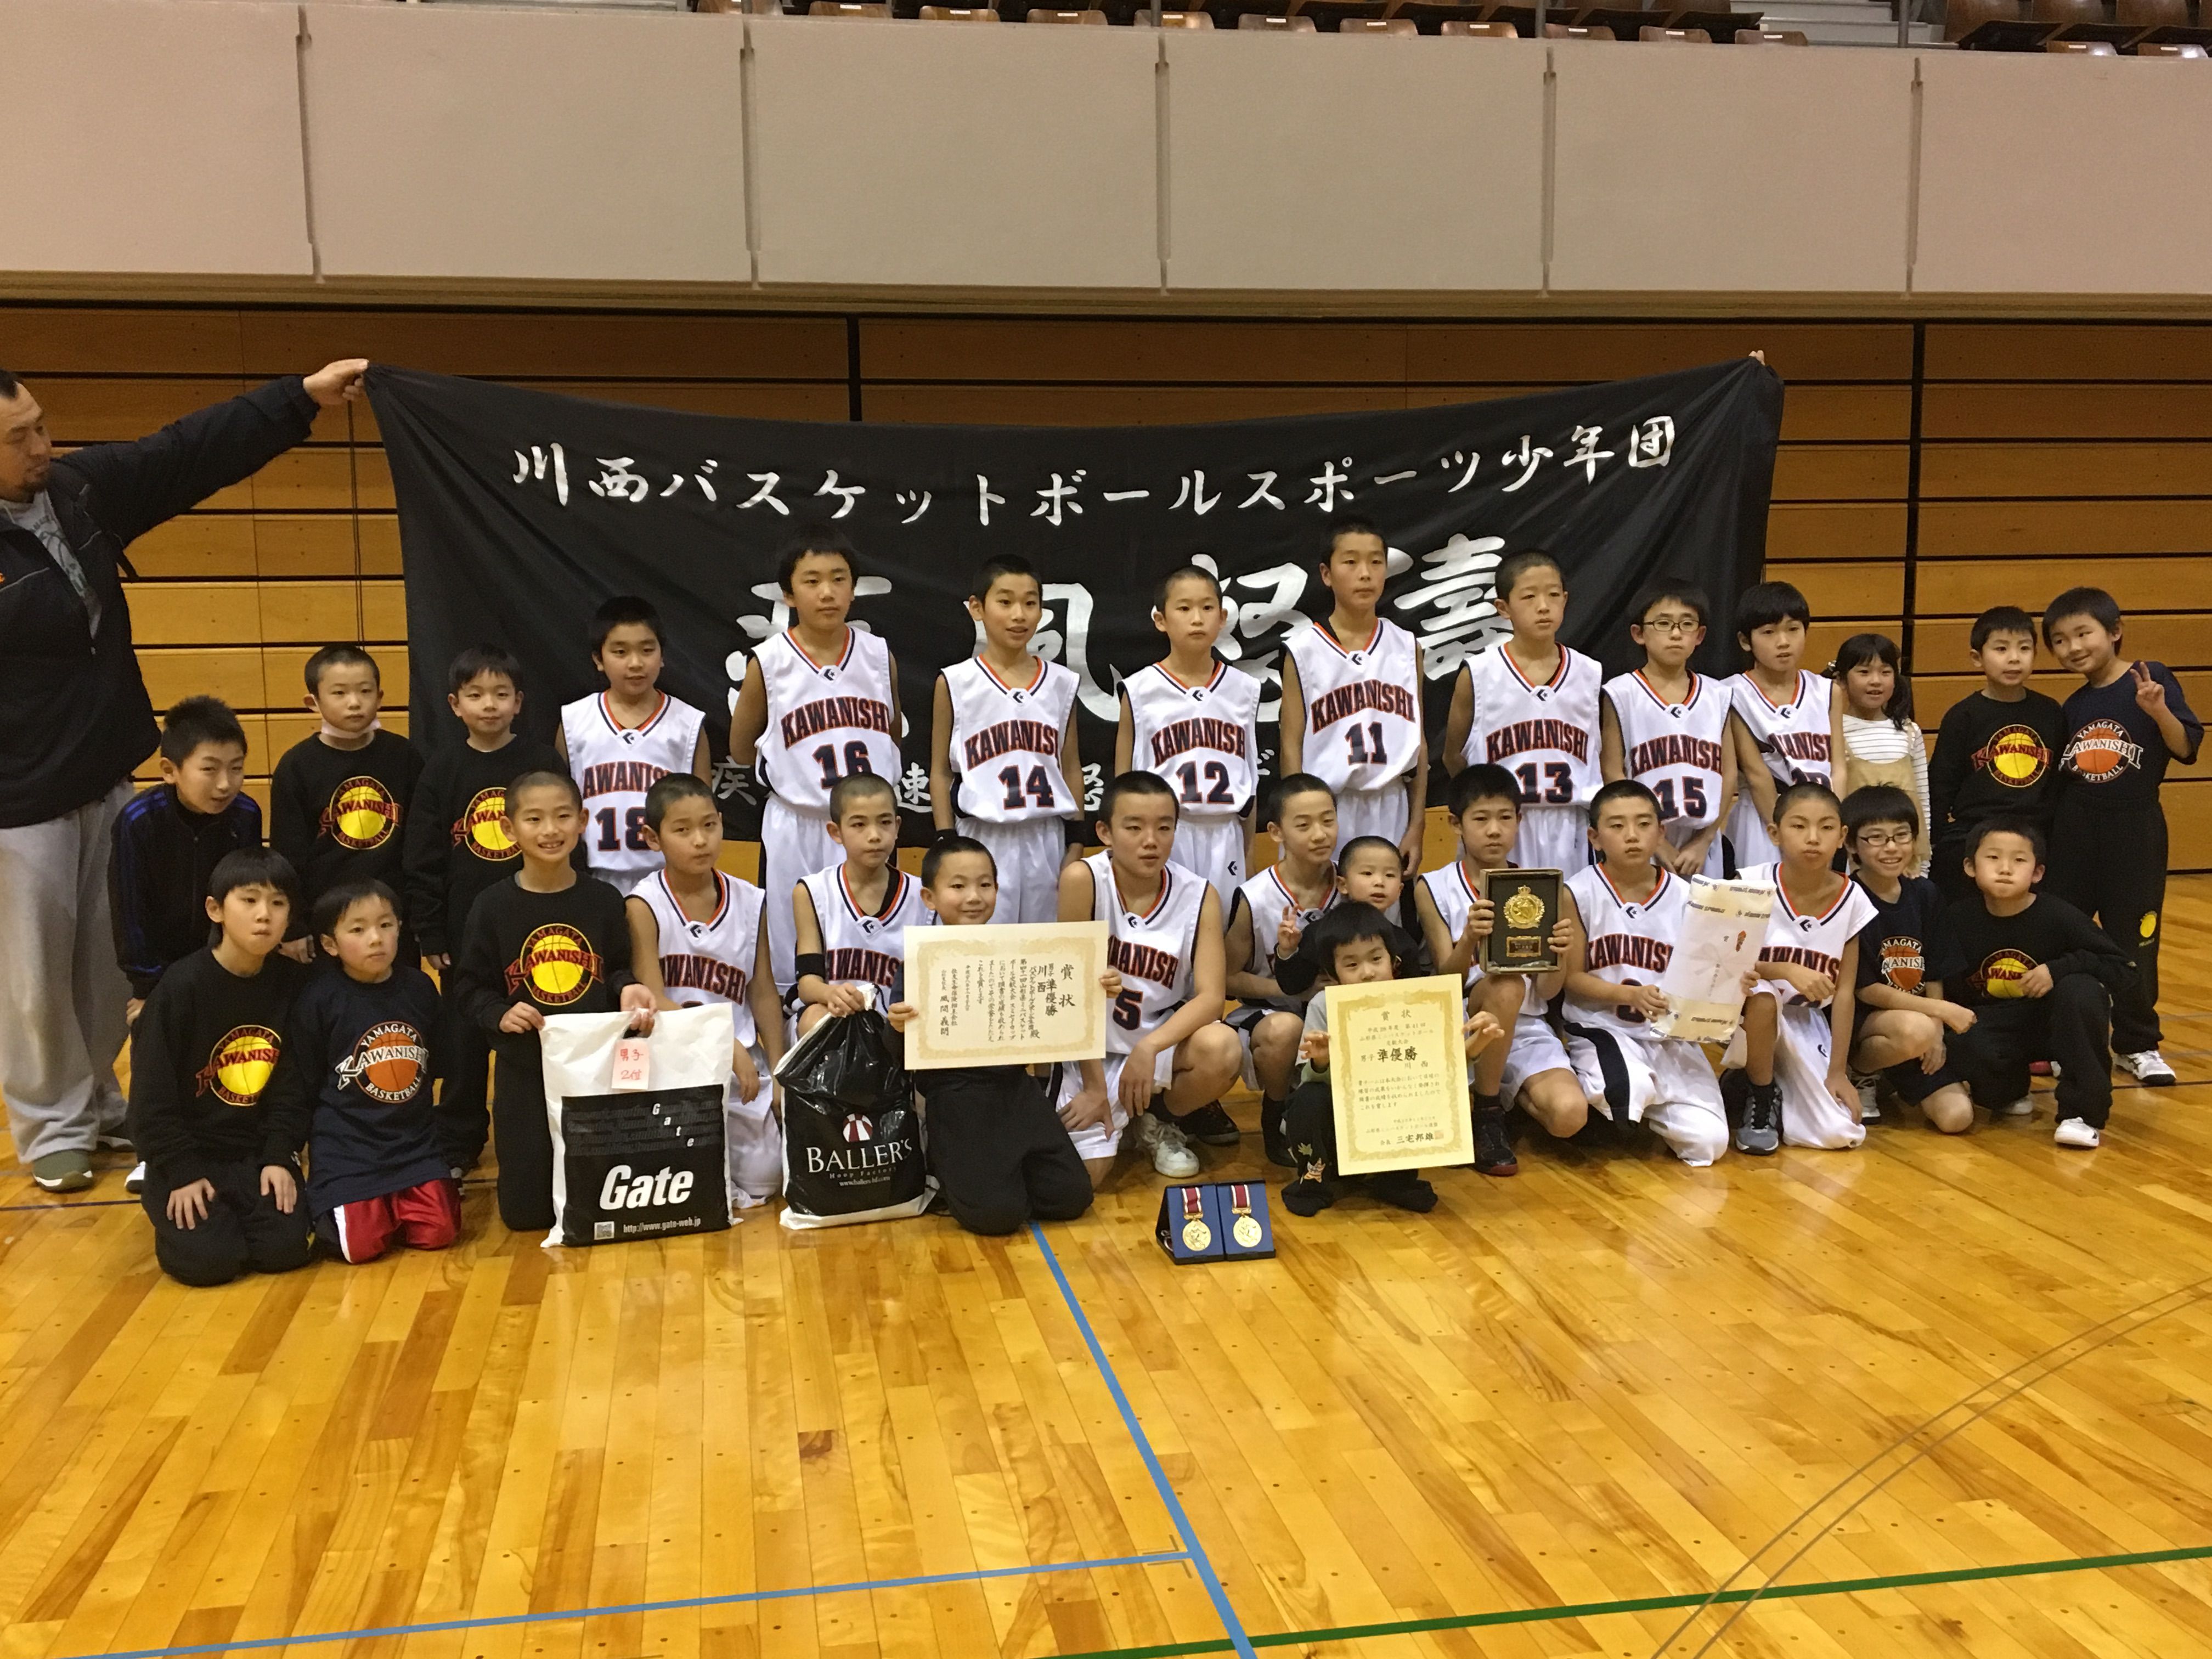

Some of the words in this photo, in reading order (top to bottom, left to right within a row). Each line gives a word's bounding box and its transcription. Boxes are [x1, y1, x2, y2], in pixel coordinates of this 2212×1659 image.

[514, 415, 1674, 526] 川西バスケットボールスポーツ少年団
[1311, 679, 1417, 735] KAWANISHI
[964, 719, 1061, 771] KAWANIS
[1151, 717, 1245, 769] KAWANISH
[1344, 721, 1387, 766] 11
[1486, 719, 1589, 766] KAWANISHI
[2077, 721, 2124, 740] YAMAGATA
[812, 741, 873, 790] 16
[1630, 734, 1723, 779] KAWANISH
[336, 778, 385, 800] YAMAGATA
[472, 789, 505, 809] YAMAG
[583, 761, 669, 800] AWANI
[998, 765, 1055, 810] 14
[1176, 760, 1235, 804] 12
[1515, 762, 1573, 804] 13
[1652, 776, 1707, 819] 15
[338, 830, 389, 847] BASKETBALL
[450, 810, 505, 849] KAWAN
[472, 841, 522, 858] BASKETBA
[527, 927, 583, 948] YAMAGATA
[1588, 934, 1674, 973] AWANIS
[1882, 939, 1922, 955] MAGATA
[504, 949, 604, 996] KAWANISHI
[659, 953, 746, 1006] WANISHI
[826, 947, 904, 988] AWANIS
[1037, 965, 1047, 992] 川西
[1108, 934, 1178, 990] WANISH
[532, 982, 587, 1002] BASKETBALL
[1046, 978, 1058, 1016] 準優勝
[1059, 964, 1075, 1007] 賞状
[1113, 986, 1143, 1031] 5
[361, 1024, 417, 1047] YAMAGATA
[620, 1048, 644, 1062] 男子
[1377, 1046, 1418, 1062] 準優勝
[196, 1048, 280, 1098] KAWANISH
[335, 1045, 429, 1091] KAWANISHI
[365, 1076, 421, 1100] BASKETBALL
[219, 1086, 256, 1104] BASKET
[806, 1138, 912, 1173] BALLER'S
[1397, 1132, 1434, 1144] 三宅邦雄
[600, 1165, 694, 1210] Gate
[623, 1216, 701, 1233] http://www.gate-web.jp
